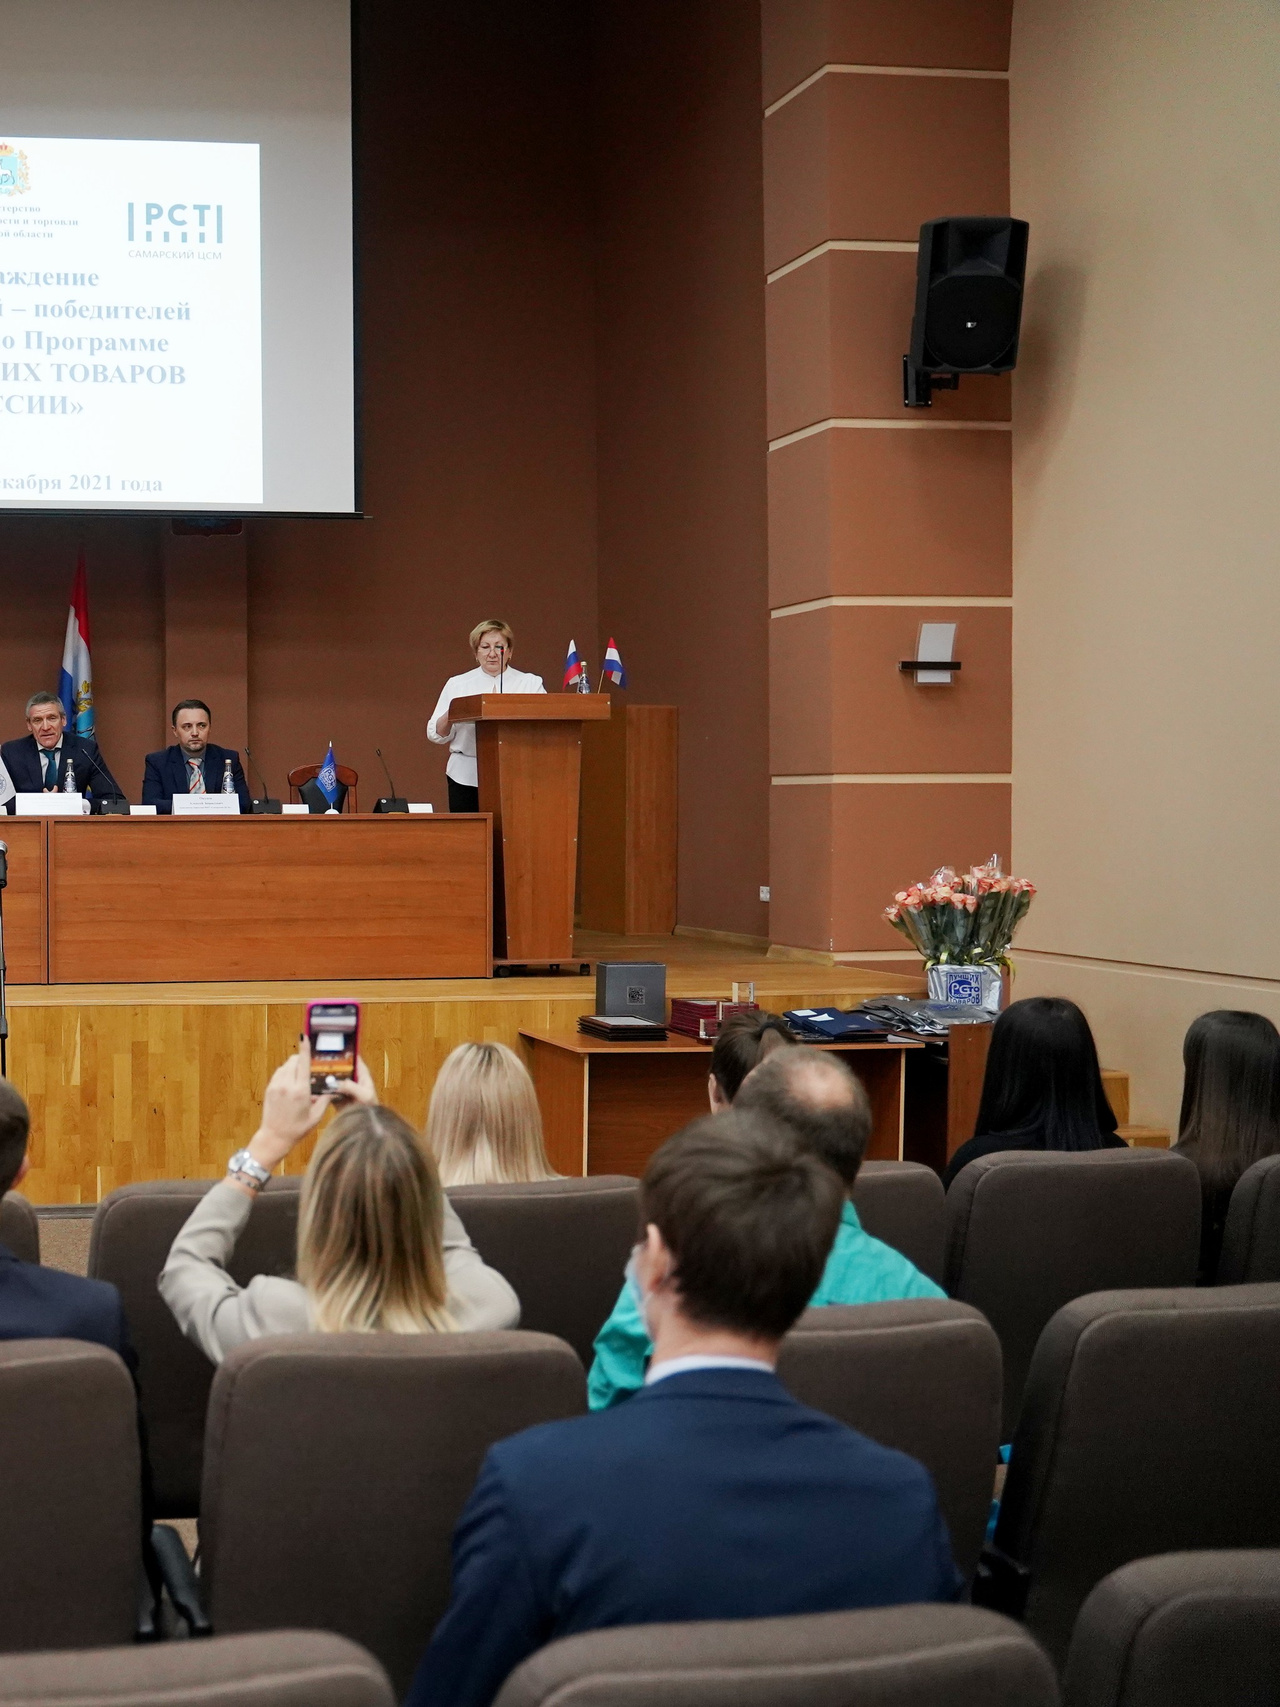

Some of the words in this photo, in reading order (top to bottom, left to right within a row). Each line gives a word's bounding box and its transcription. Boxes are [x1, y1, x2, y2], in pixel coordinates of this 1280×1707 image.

[33, 219, 79, 228] торговли
[13, 230, 53, 239] области
[128, 250, 194, 260] САМАРСКИЙ
[198, 252, 222, 260] ЦСМ
[34, 299, 191, 321] победителей
[25, 331, 169, 357] Программе
[50, 363, 186, 385] ТОВАРОВ
[69, 474, 111, 490] 2021
[121, 480, 162, 492] года
